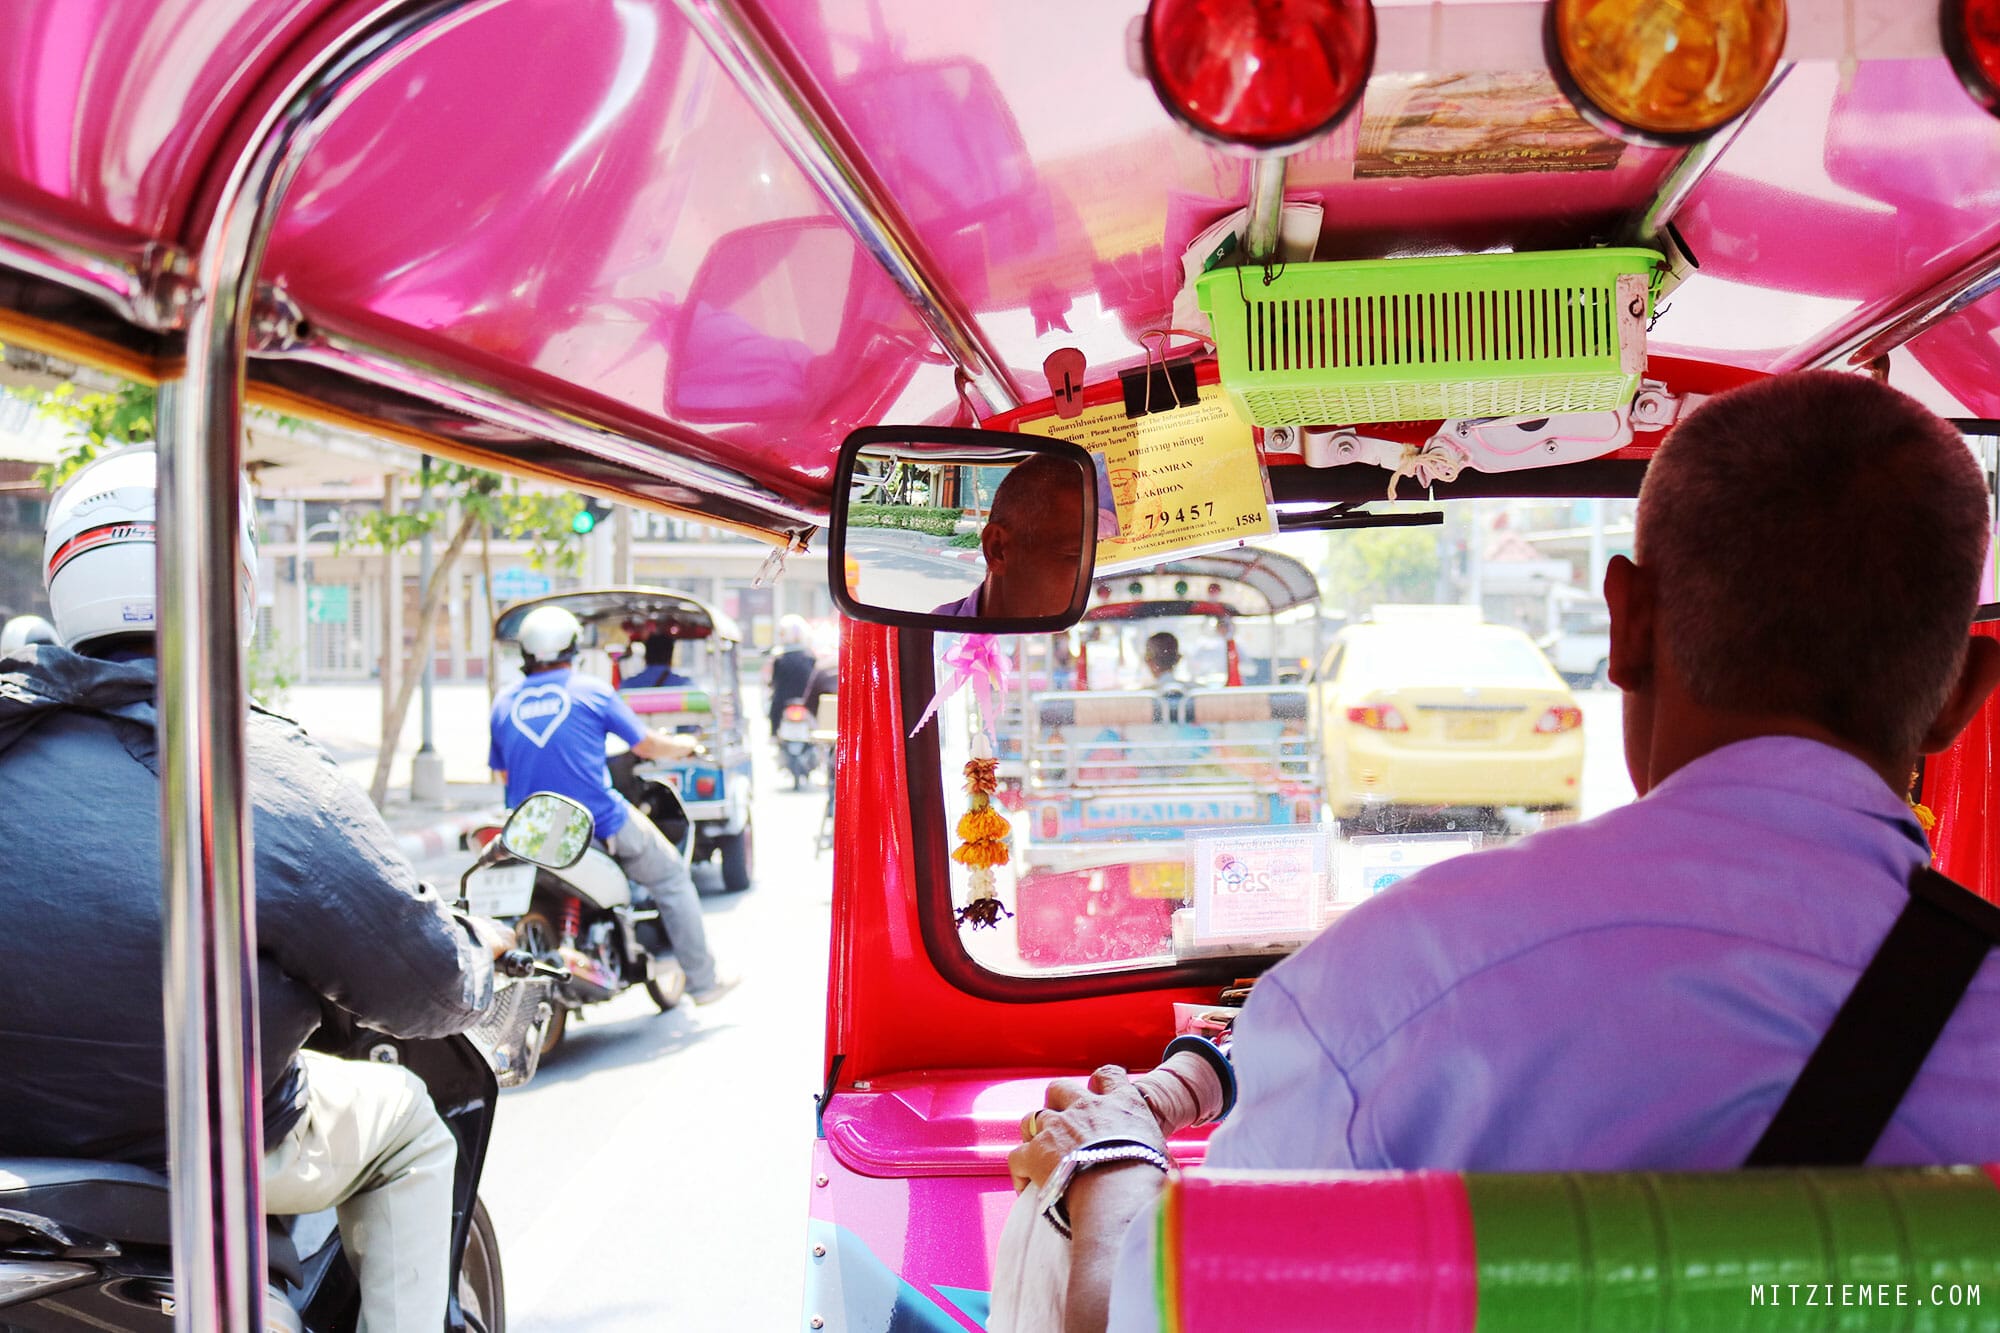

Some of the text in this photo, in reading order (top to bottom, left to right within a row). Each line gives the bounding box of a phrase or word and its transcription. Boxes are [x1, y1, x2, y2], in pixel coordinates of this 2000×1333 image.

[1090, 429, 1110, 437] Please
[1132, 470, 1151, 479] MR.
[1152, 460, 1193, 474] SAMRAN
[1145, 501, 1213, 530] 79457
[1133, 540, 1165, 552] PASSENGER
[1166, 532, 1202, 545] PROTECTION
[1236, 511, 1262, 527] 1584
